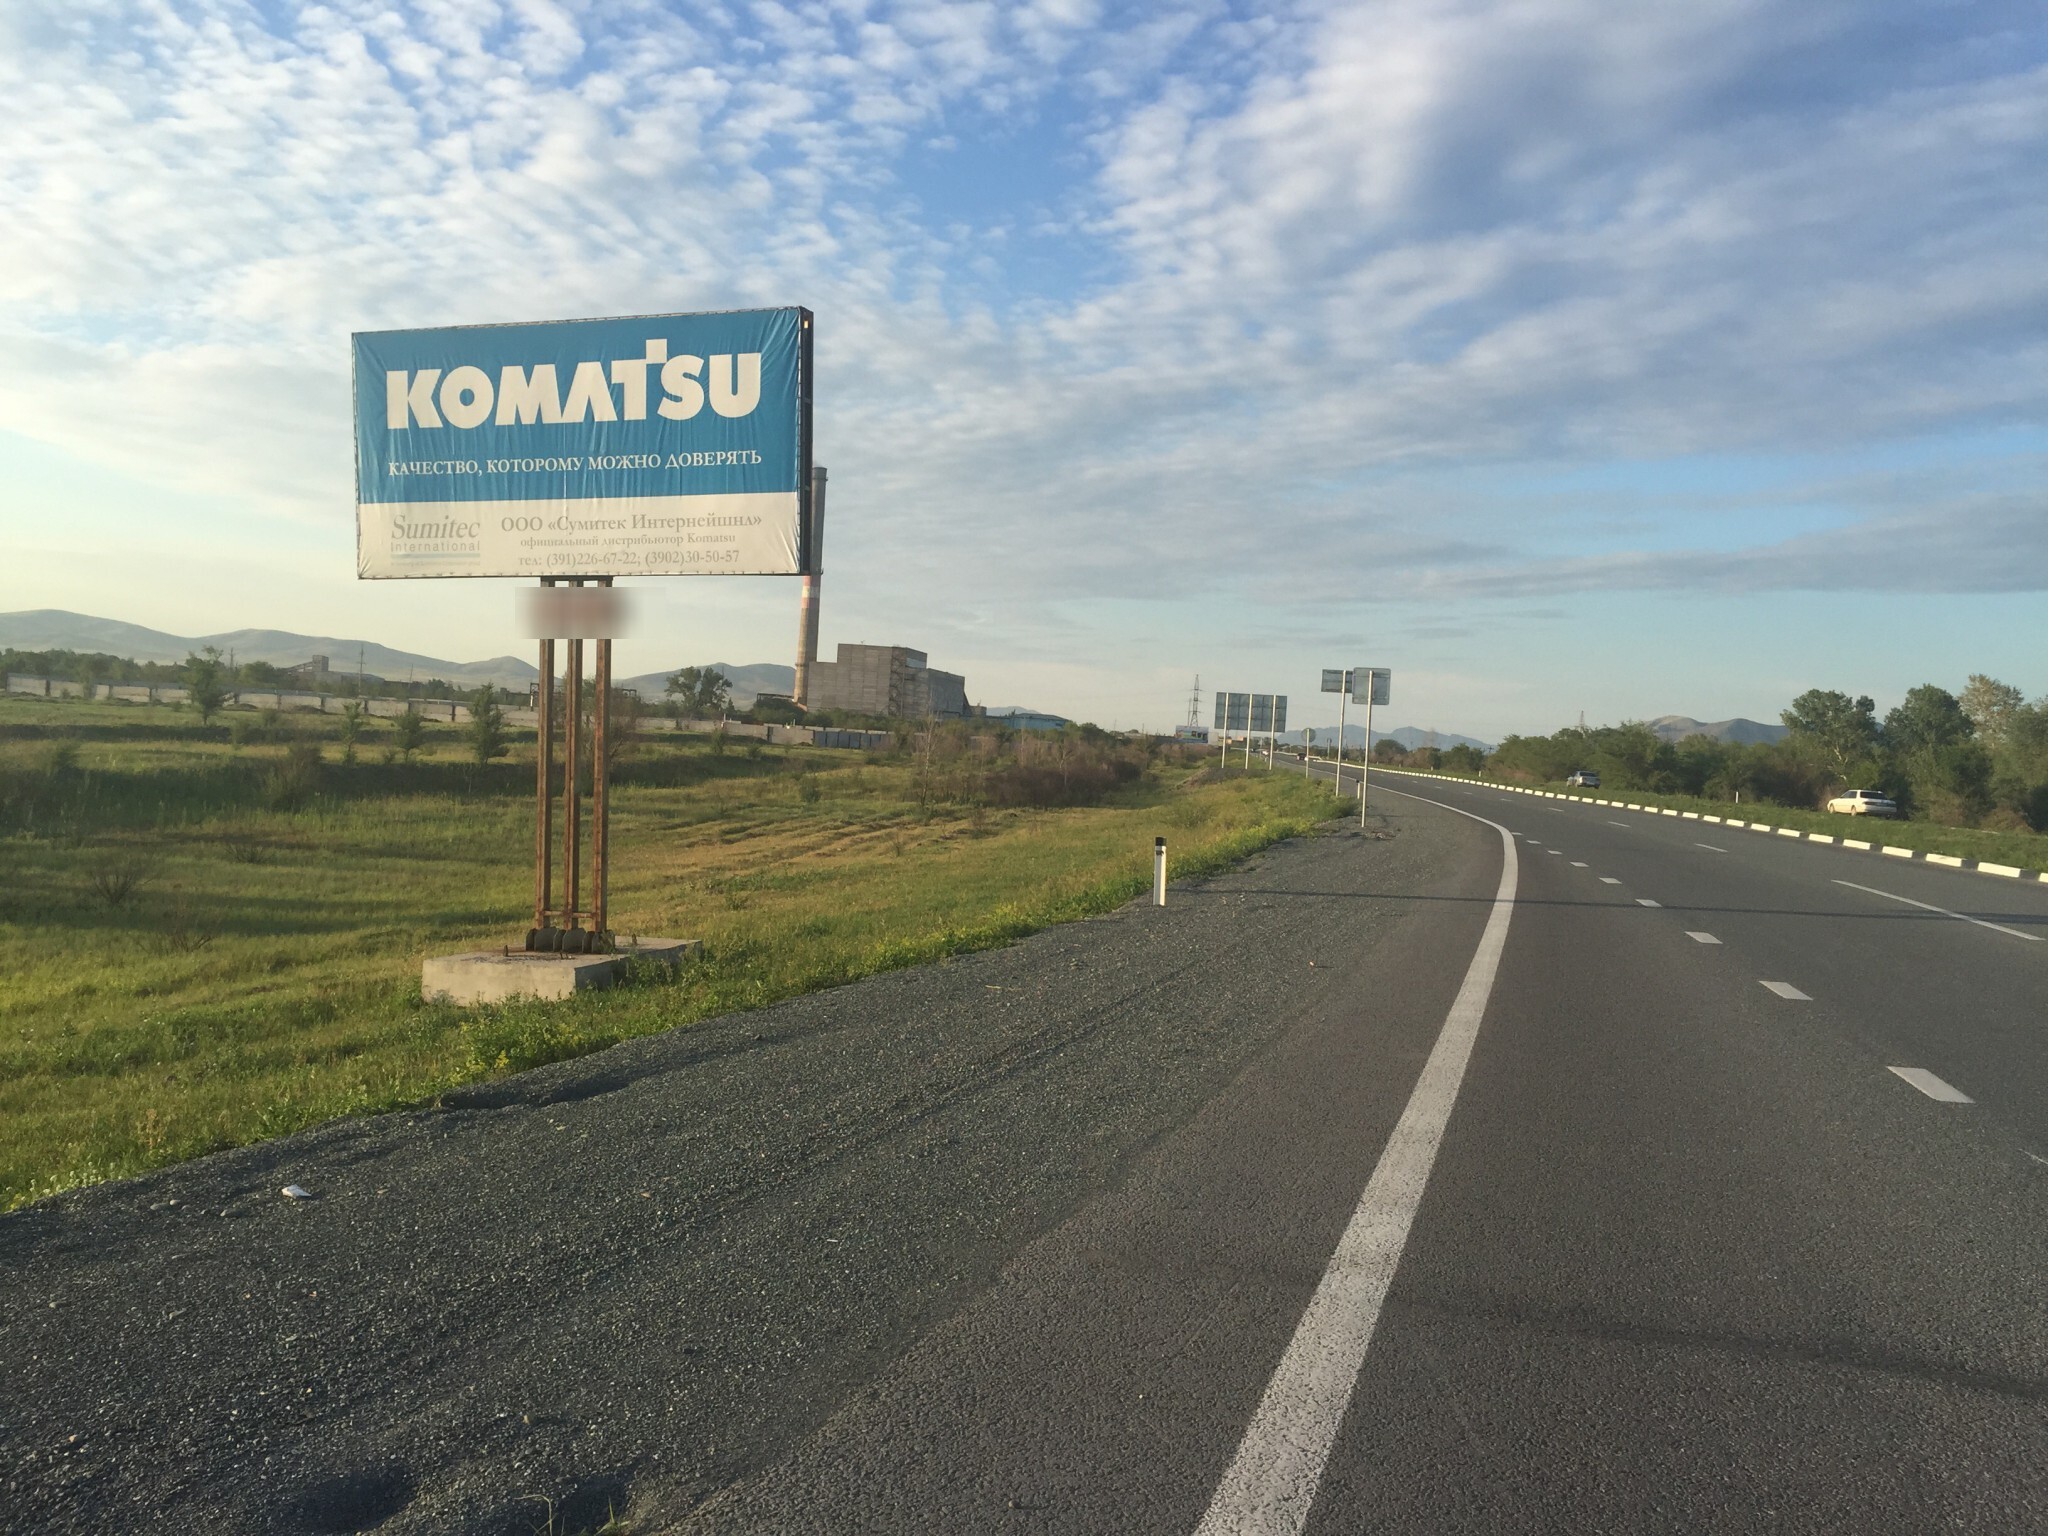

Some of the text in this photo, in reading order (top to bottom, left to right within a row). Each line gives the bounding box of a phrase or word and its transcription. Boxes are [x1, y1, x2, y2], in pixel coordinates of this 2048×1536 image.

[386, 338, 762, 429] KOMATSU
[388, 450, 762, 476] КАЧЕСТВО, КОТОРОМУ МОЖНО ДОВЕРЯТЬ
[391, 514, 480, 539] Sumitec
[501, 513, 762, 535] ООО «Сумитек Интернейшнл»
[391, 540, 480, 552] International
[520, 532, 736, 549] официальный дистрибьютор Komatsu
[519, 550, 740, 568] тел: (391)226-67-22; (3902)30-50-57
